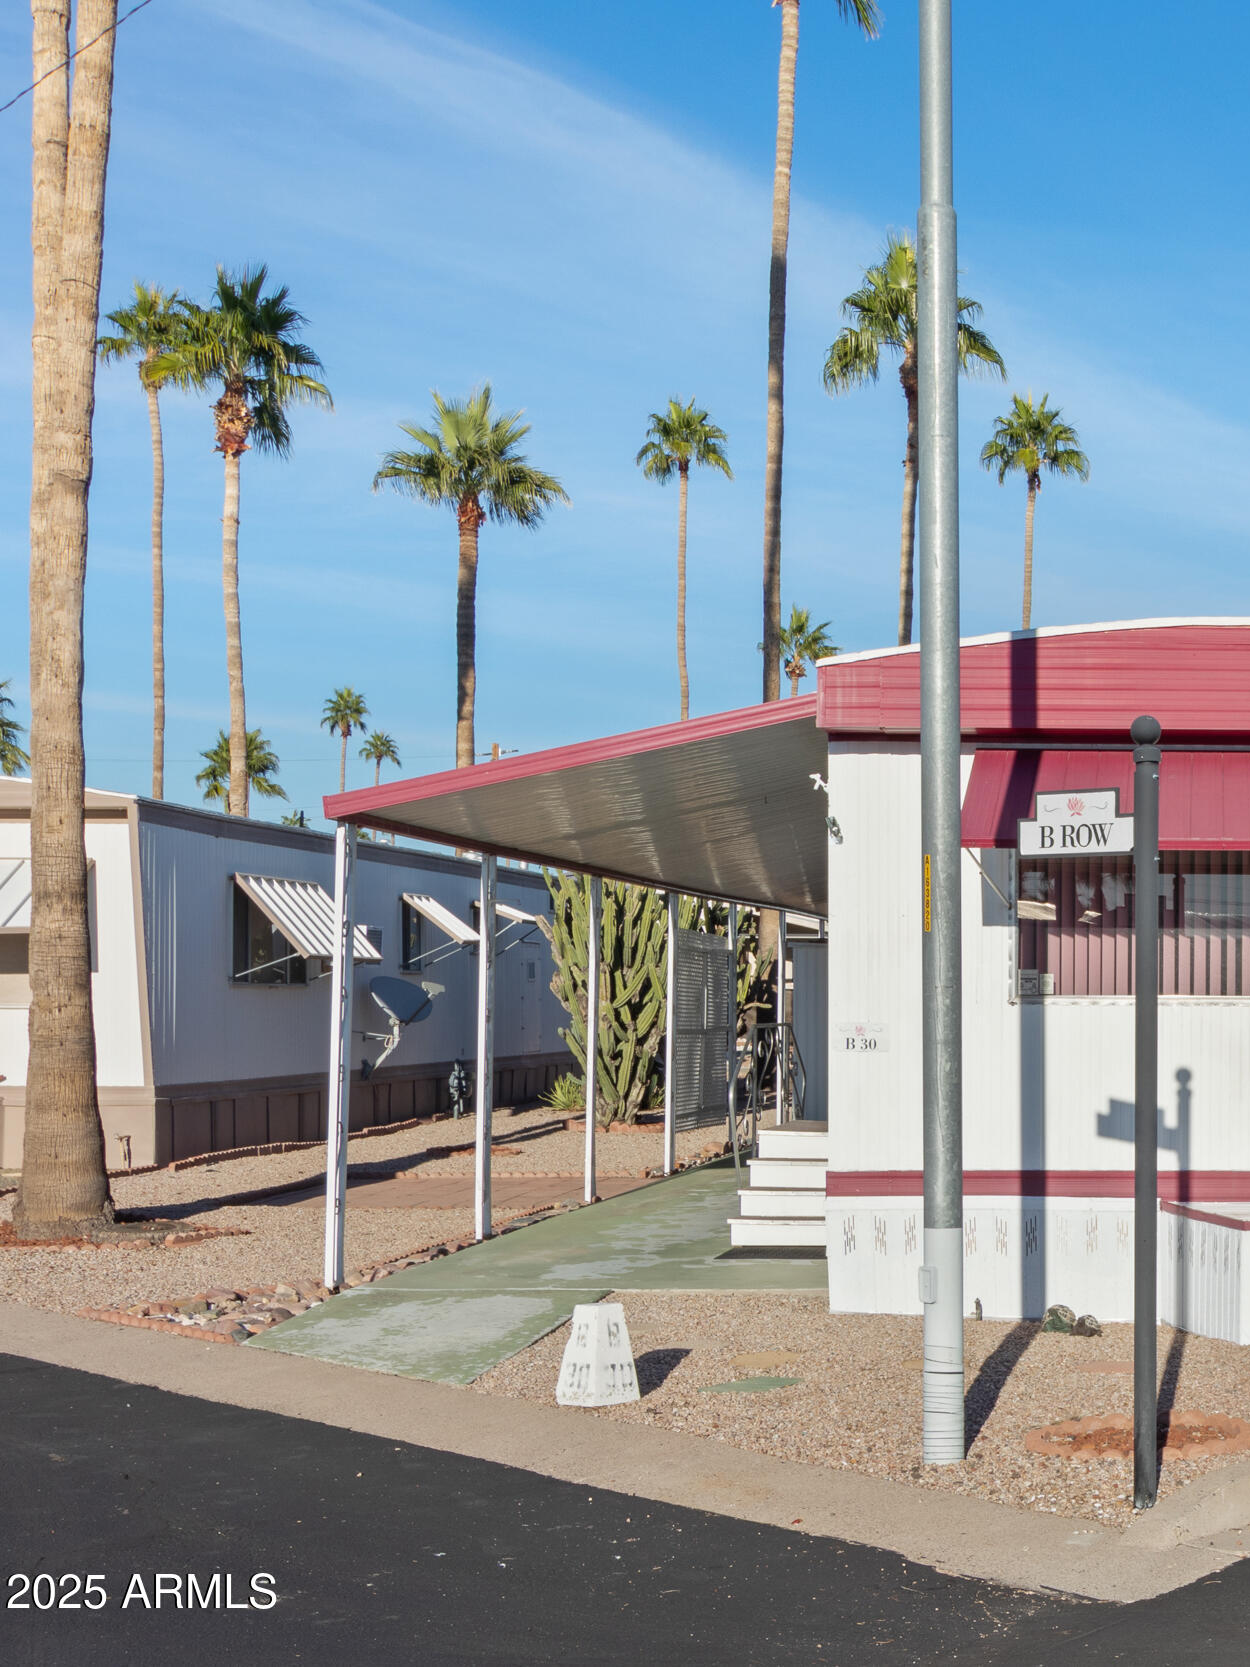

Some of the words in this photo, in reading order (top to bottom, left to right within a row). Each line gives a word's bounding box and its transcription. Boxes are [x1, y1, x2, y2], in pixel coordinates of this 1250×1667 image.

[1039, 825, 1055, 849] B
[1060, 822, 1114, 848] ROW
[846, 1037, 855, 1050] B
[860, 1038, 877, 1050] 30
